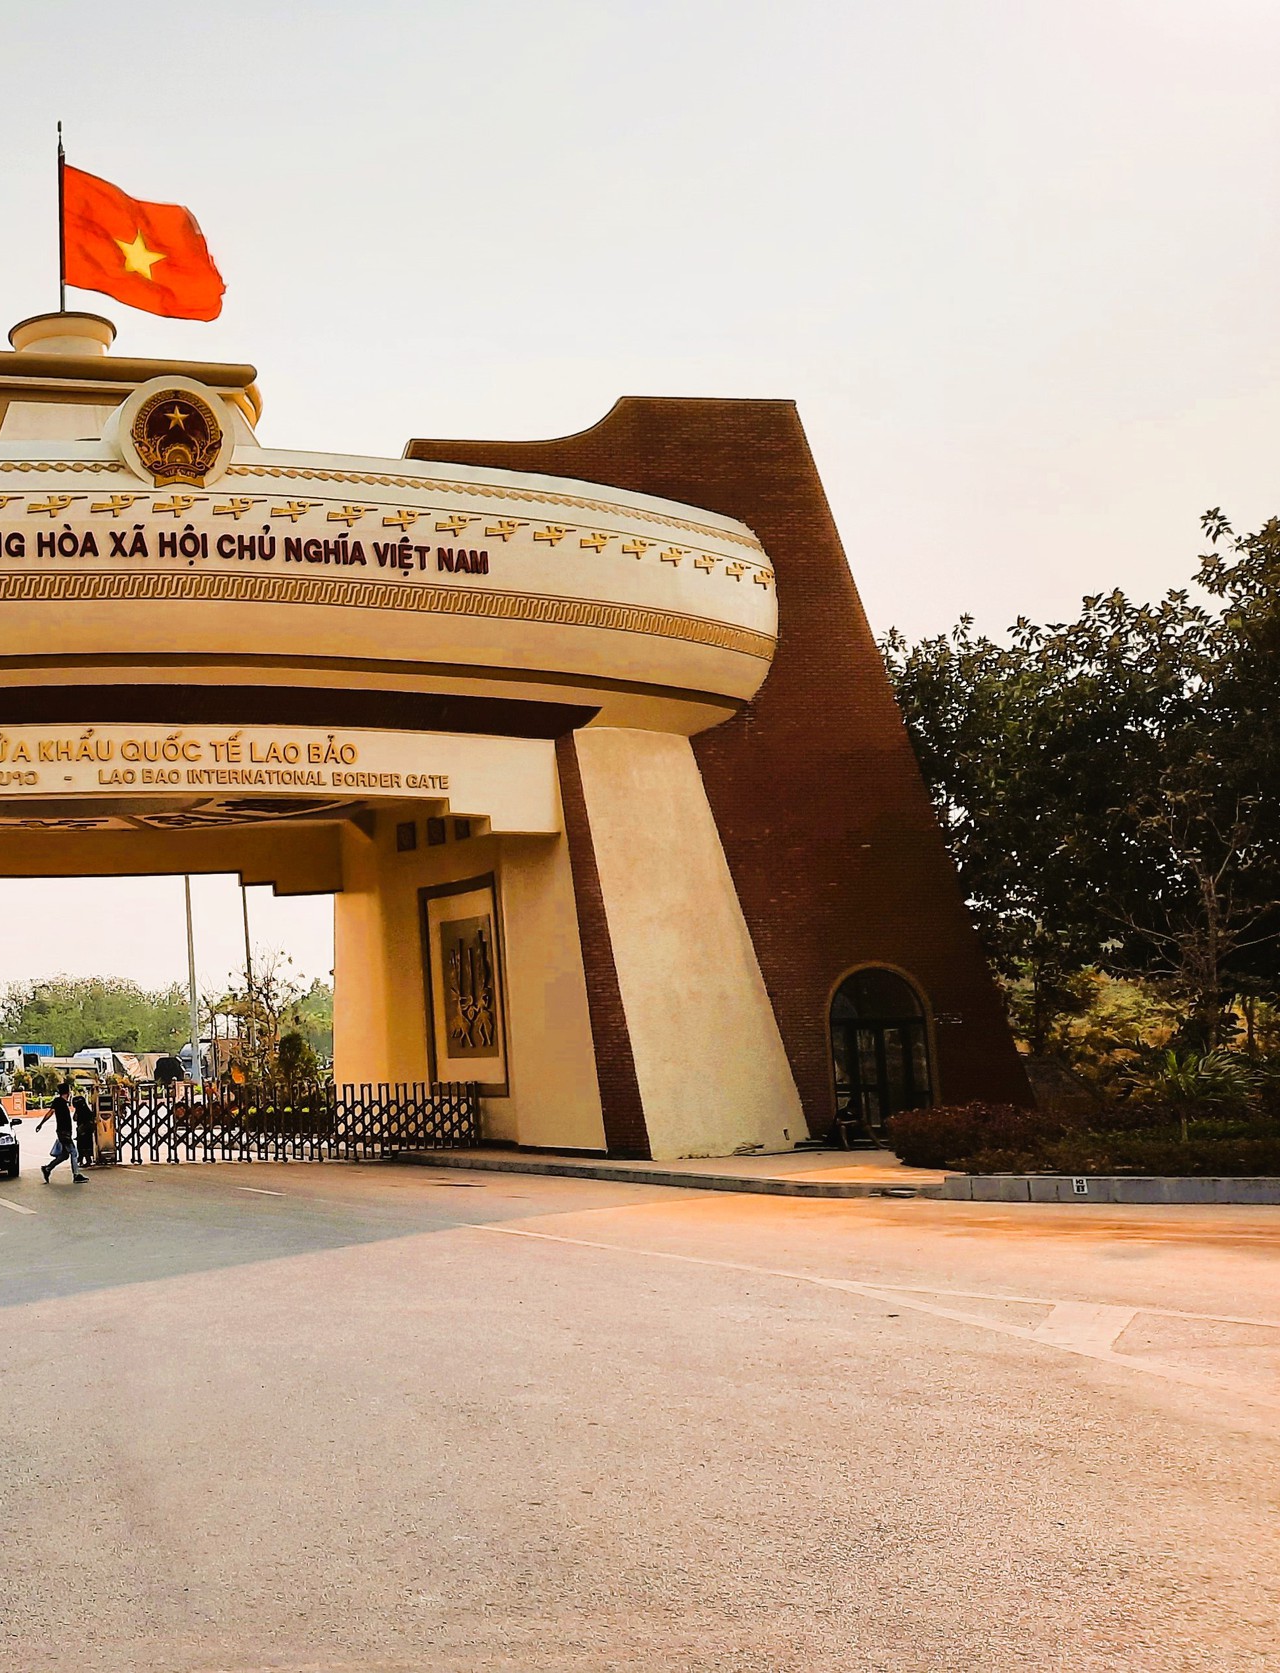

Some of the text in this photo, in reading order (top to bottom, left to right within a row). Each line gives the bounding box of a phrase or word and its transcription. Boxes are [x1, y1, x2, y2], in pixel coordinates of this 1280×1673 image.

[36, 524, 99, 558] HÒA
[108, 525, 149, 558] XÃ
[158, 524, 208, 566] HỘI
[216, 525, 276, 560] CHỦ
[284, 532, 367, 566] NGHĨA
[372, 537, 431, 576] VIỆT
[437, 547, 490, 575] NAM
[38, 728, 114, 763] KHẨU
[120, 730, 203, 763] QUỐC
[209, 729, 243, 763] TẾ
[249, 741, 301, 764] LAO
[307, 734, 360, 765] BẢO
[98, 768, 136, 786] LAO
[141, 768, 180, 785] BAO
[187, 768, 327, 787] INTERNATIONAL
[332, 771, 402, 789] BORDER
[406, 773, 450, 790] GATE
